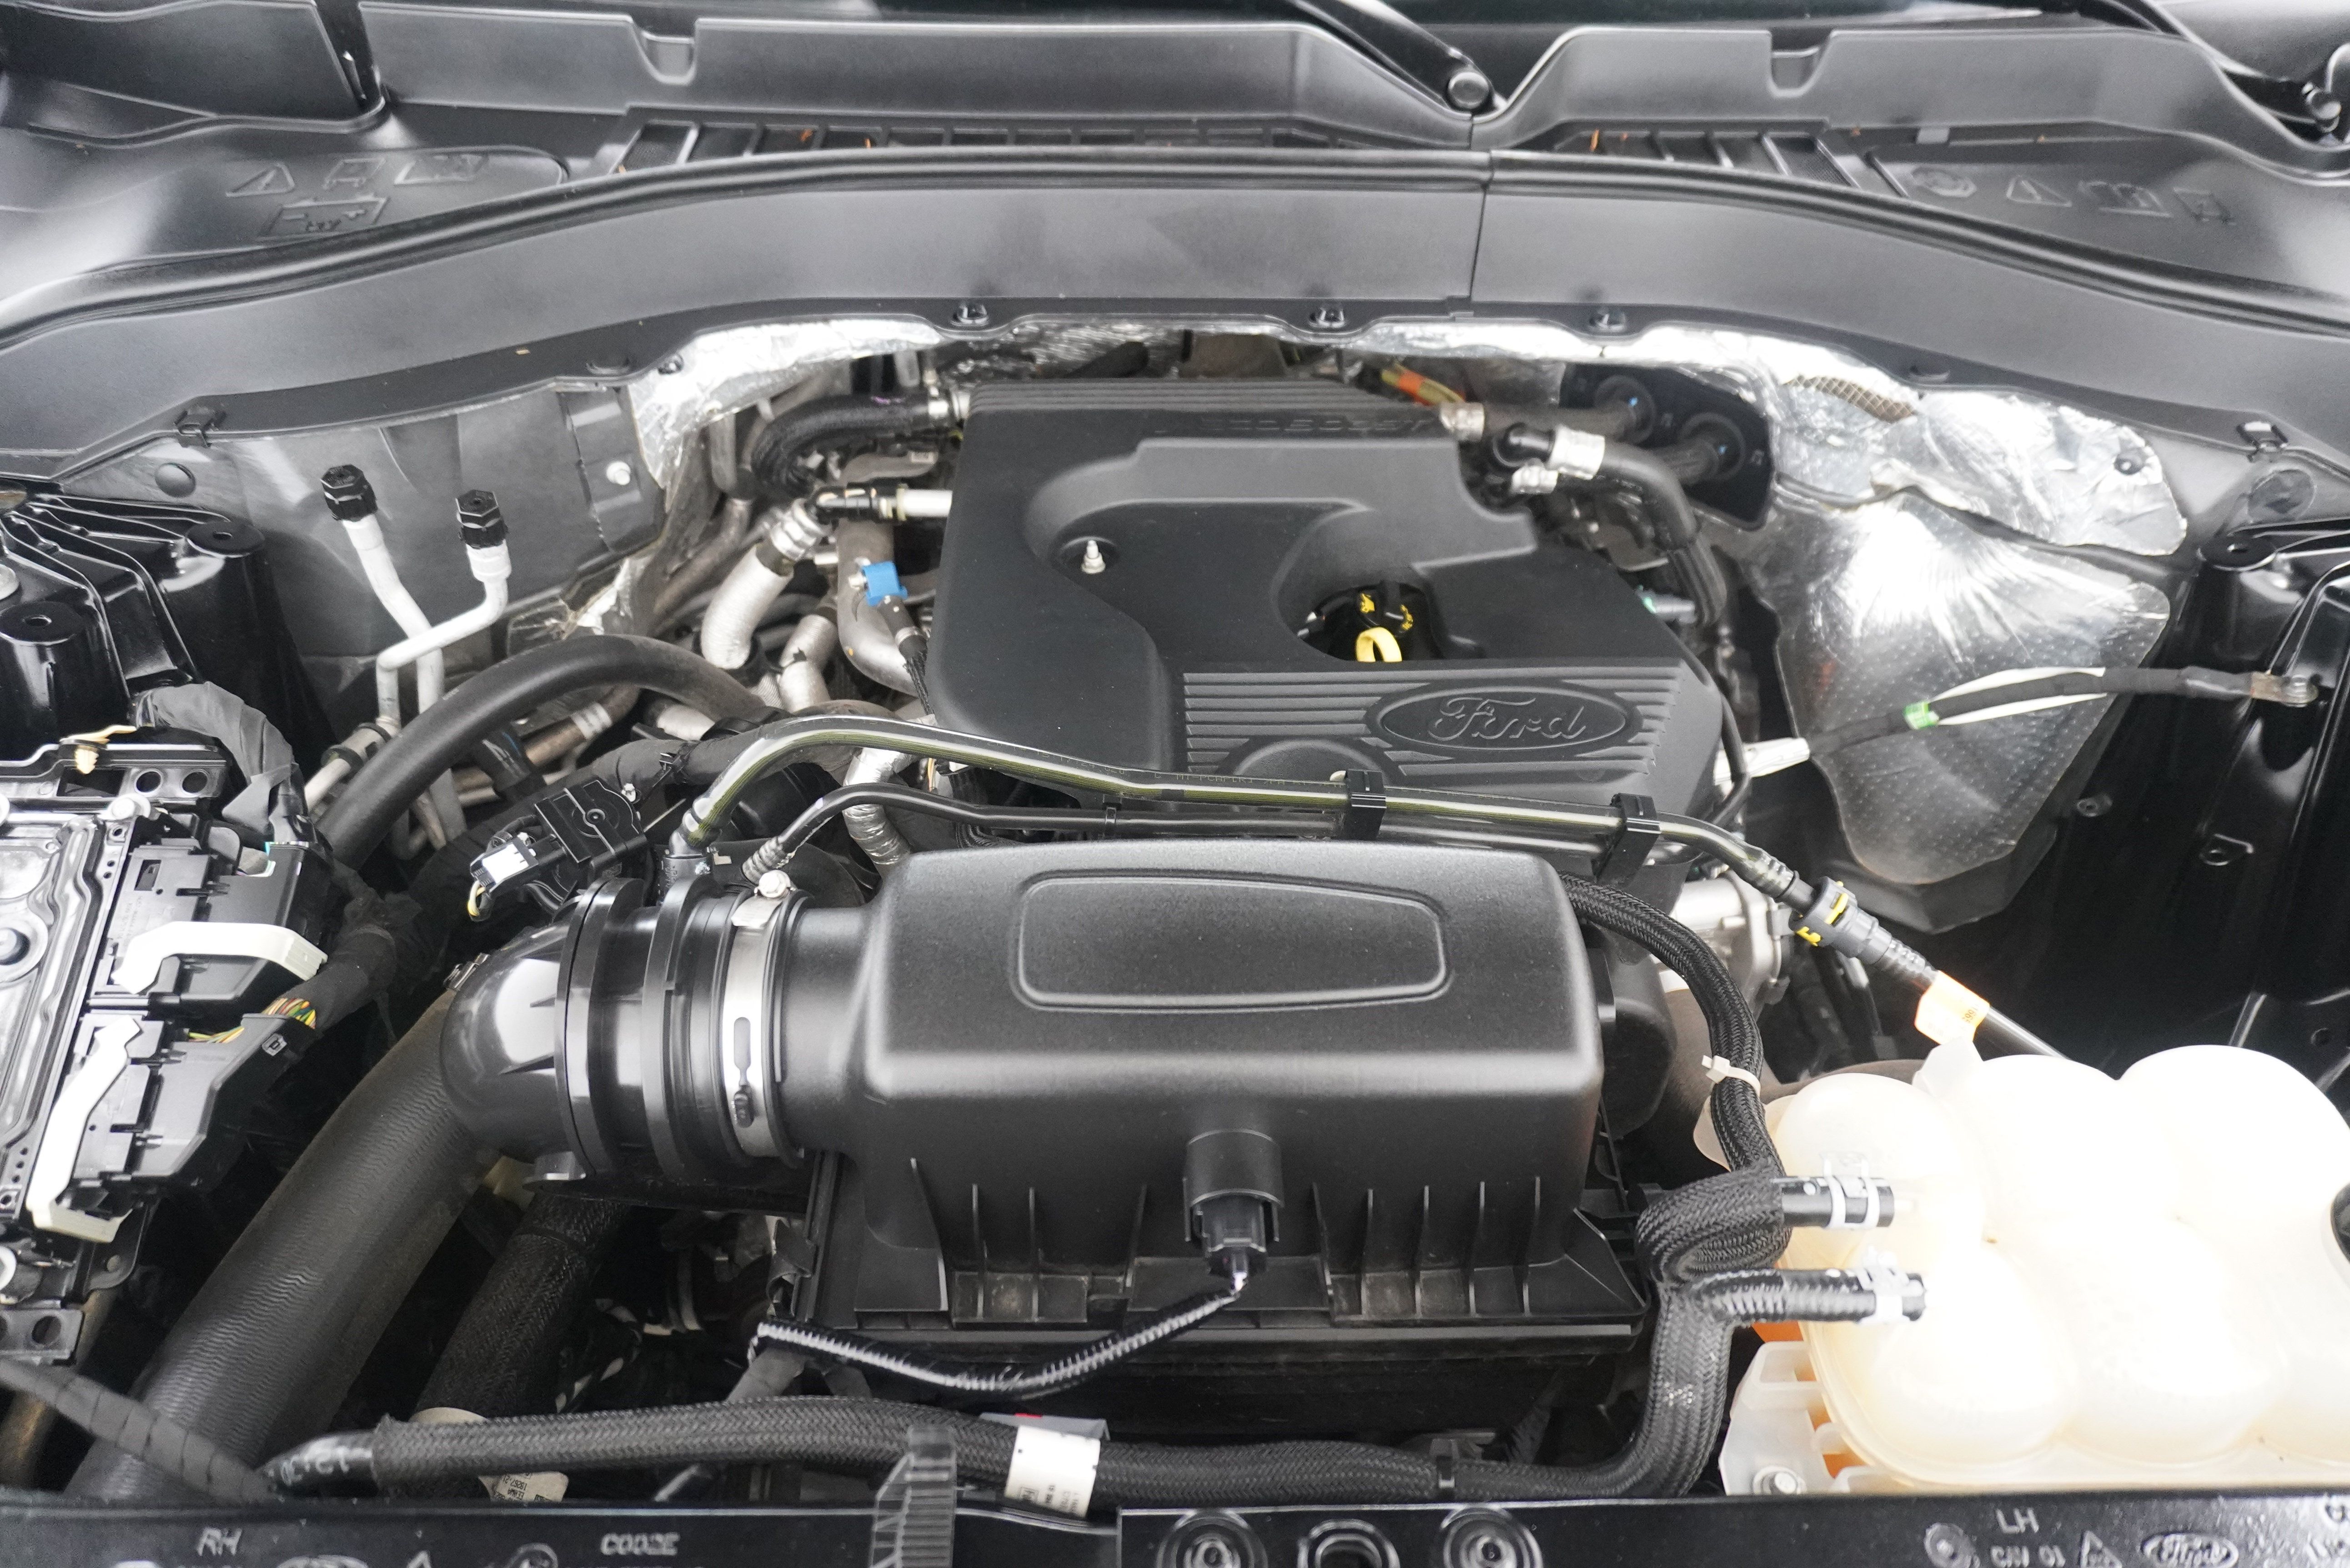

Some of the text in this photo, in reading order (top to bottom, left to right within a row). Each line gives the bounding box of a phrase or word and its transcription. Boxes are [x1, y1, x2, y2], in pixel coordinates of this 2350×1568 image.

[1427, 697, 1587, 741] Ford
[1995, 1507, 2039, 1534] LH
[196, 1526, 243, 1557] RH
